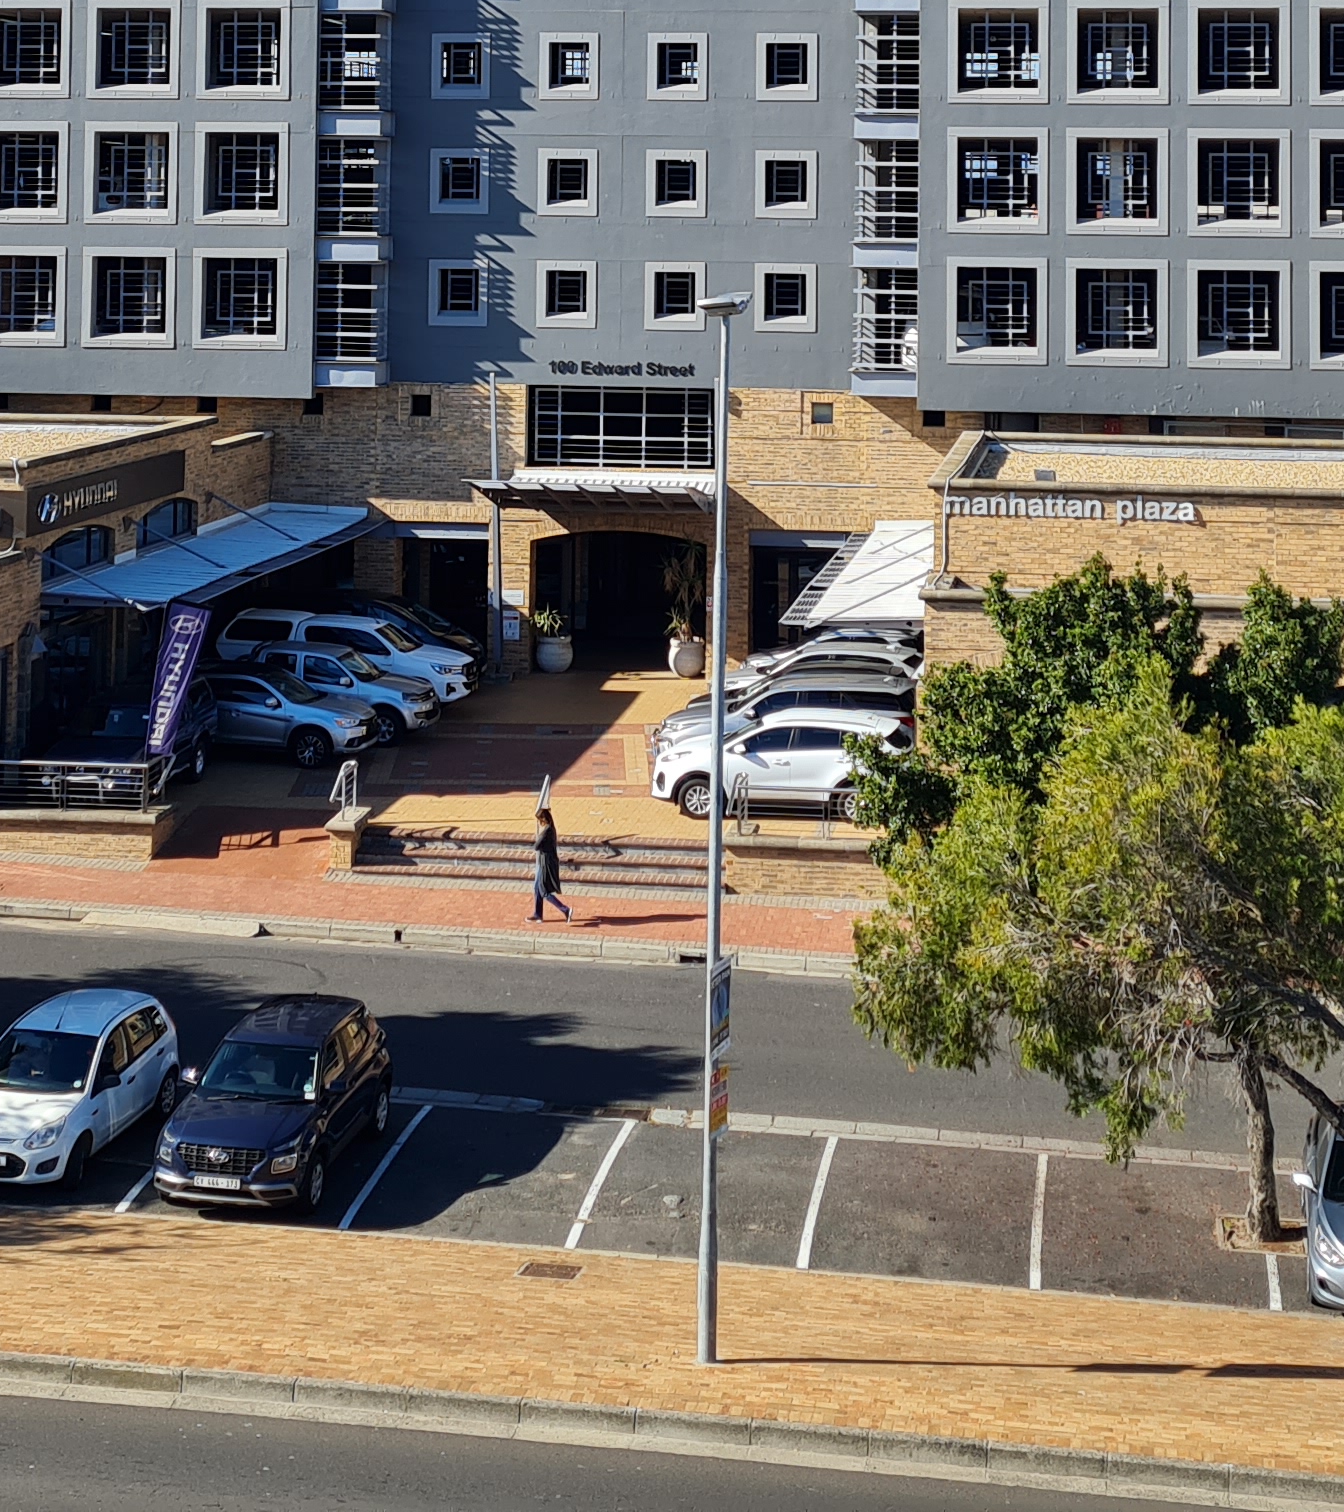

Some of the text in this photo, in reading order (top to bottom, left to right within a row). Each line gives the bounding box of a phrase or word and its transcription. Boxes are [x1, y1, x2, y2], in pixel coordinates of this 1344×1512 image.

[549, 360, 695, 377] 100 Edward Street
[63, 479, 118, 517] HYUNDAI
[945, 492, 1195, 525] manhattan plaza
